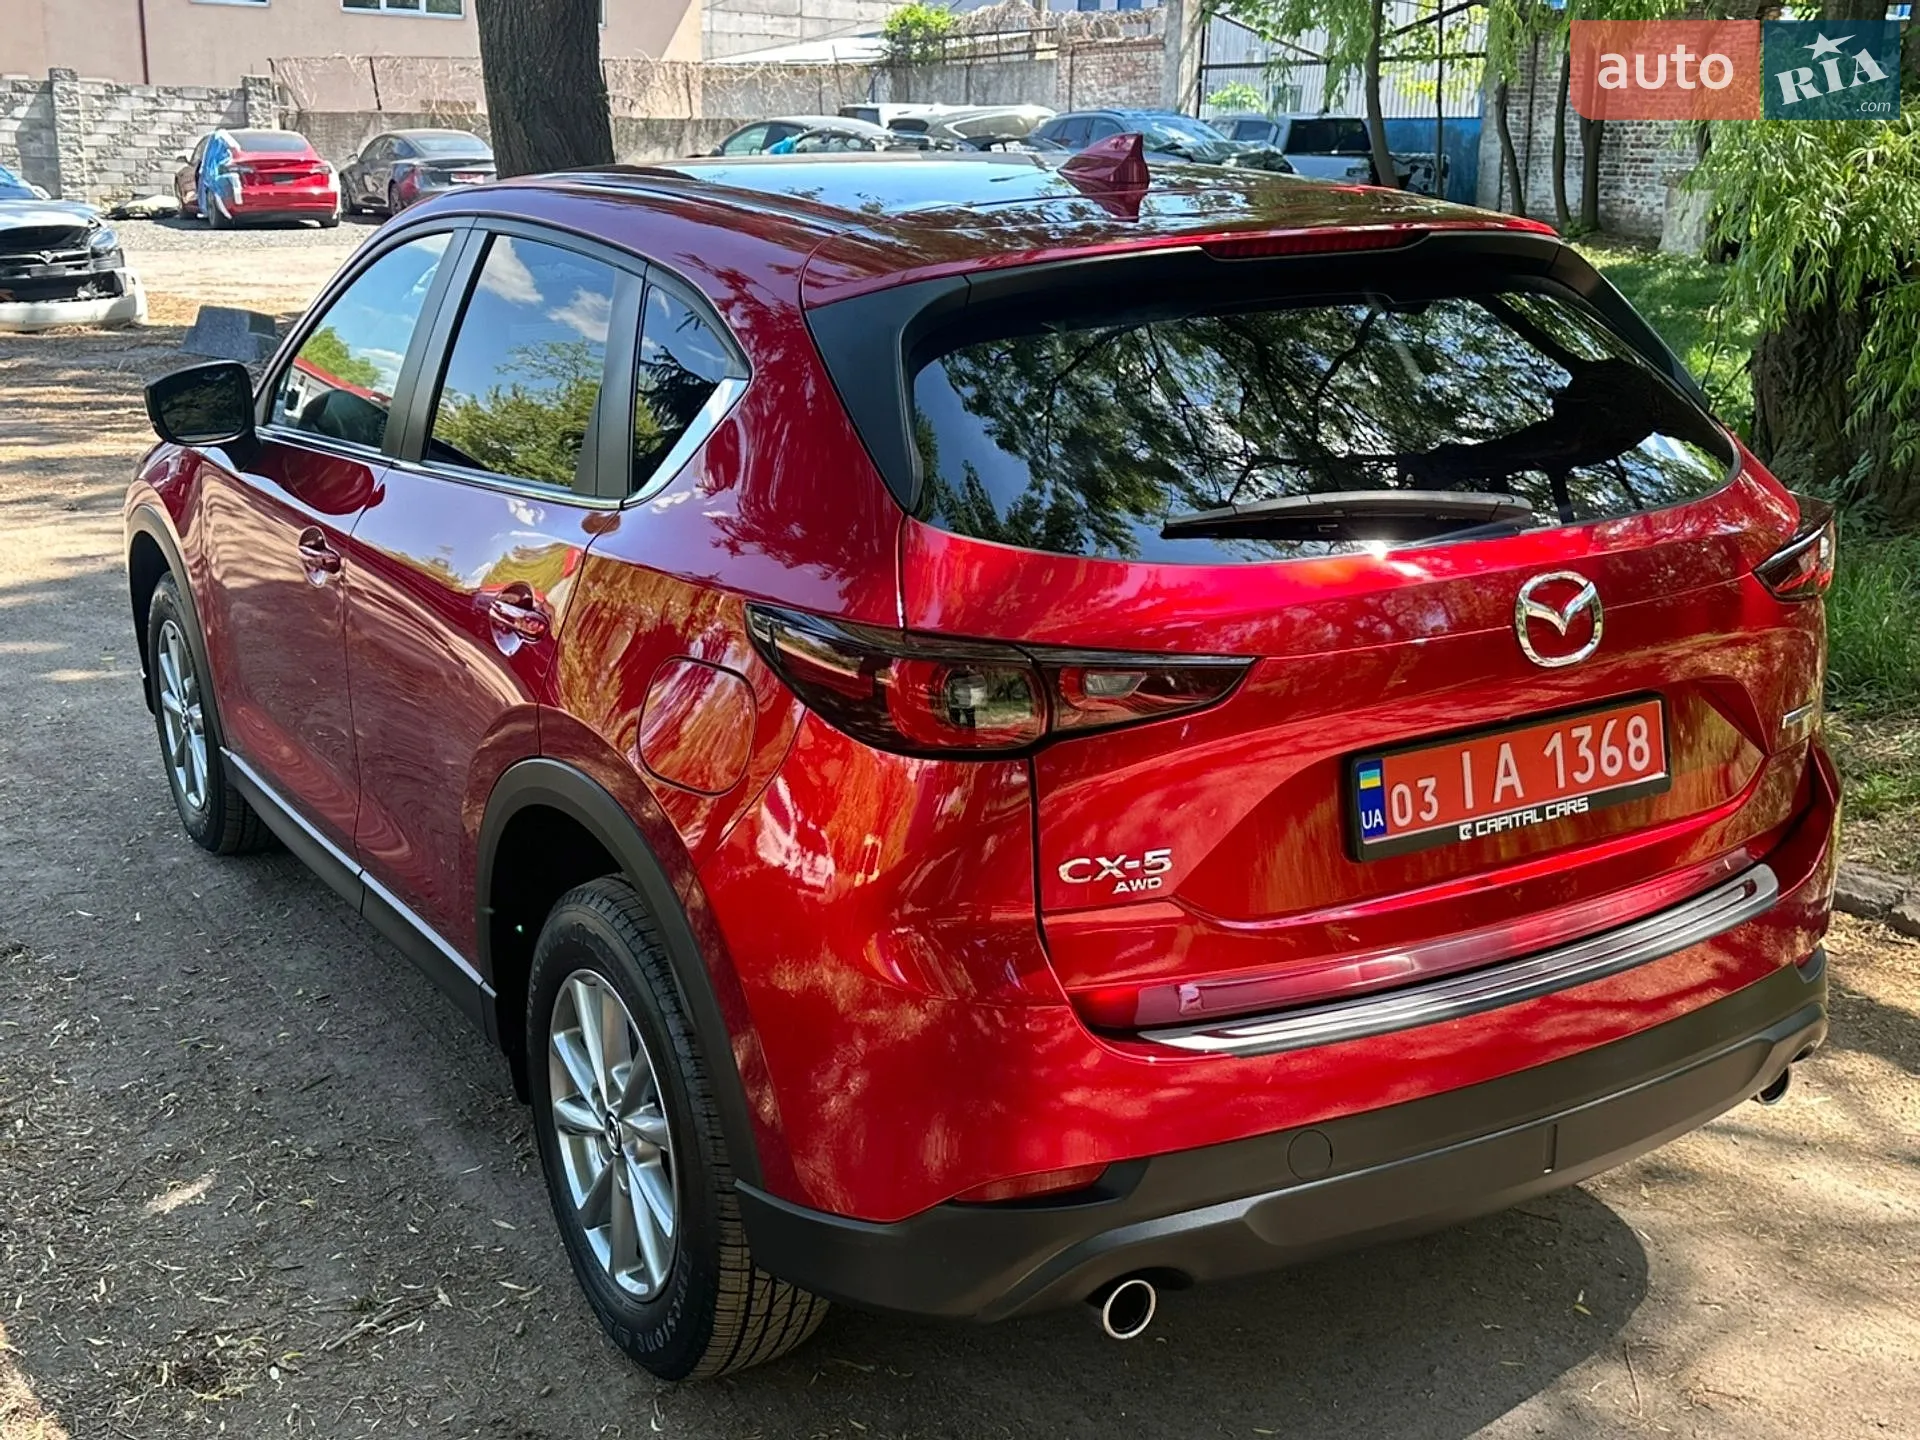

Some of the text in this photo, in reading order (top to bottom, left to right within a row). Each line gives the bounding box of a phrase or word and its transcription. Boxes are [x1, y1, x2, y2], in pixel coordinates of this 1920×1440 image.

[1391, 715, 1650, 827] 03 IA 1368
[1362, 809, 1384, 830] UA
[1475, 797, 1589, 836] CAPITAL CARS
[1058, 848, 1173, 884] CX-5
[1112, 876, 1162, 895] AWD
